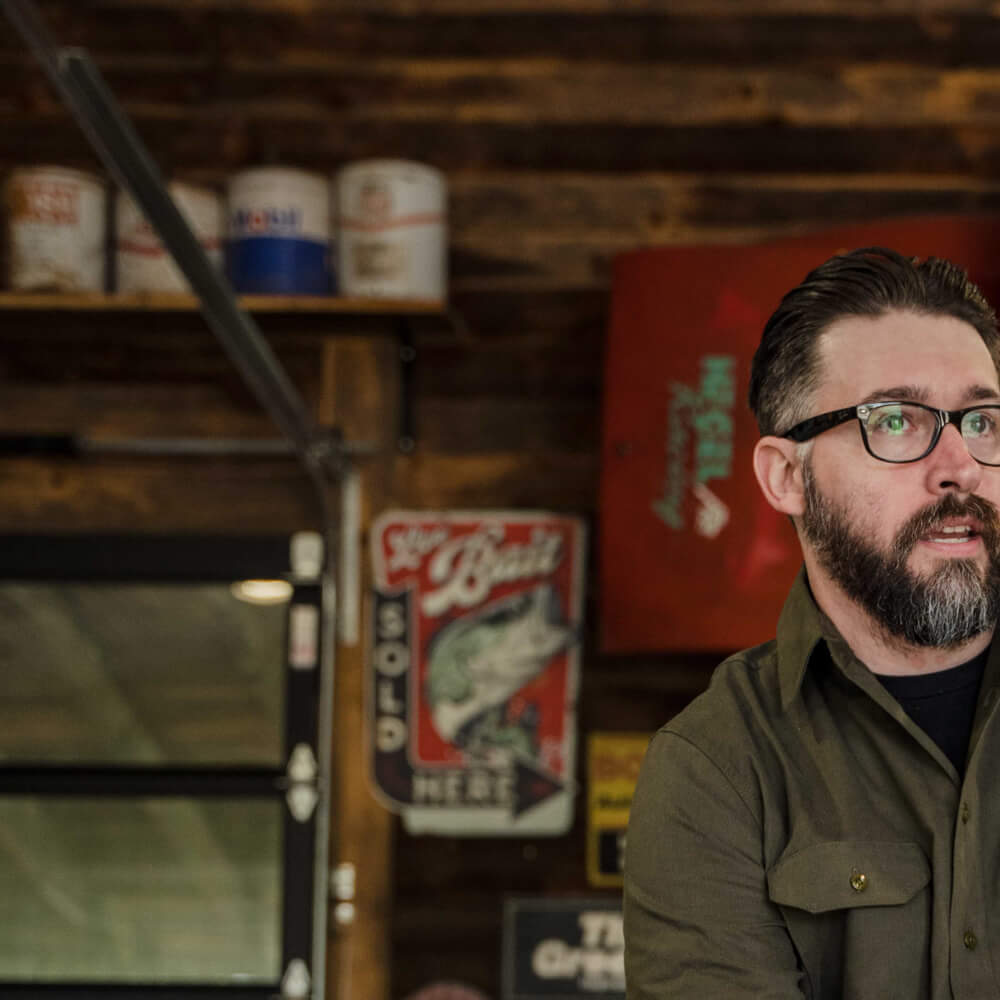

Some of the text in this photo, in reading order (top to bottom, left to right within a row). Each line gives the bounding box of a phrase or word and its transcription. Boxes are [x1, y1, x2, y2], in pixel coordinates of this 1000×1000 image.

[421, 525, 562, 617] Bait
[374, 600, 411, 753] SOLD
[413, 770, 513, 803] HERE
